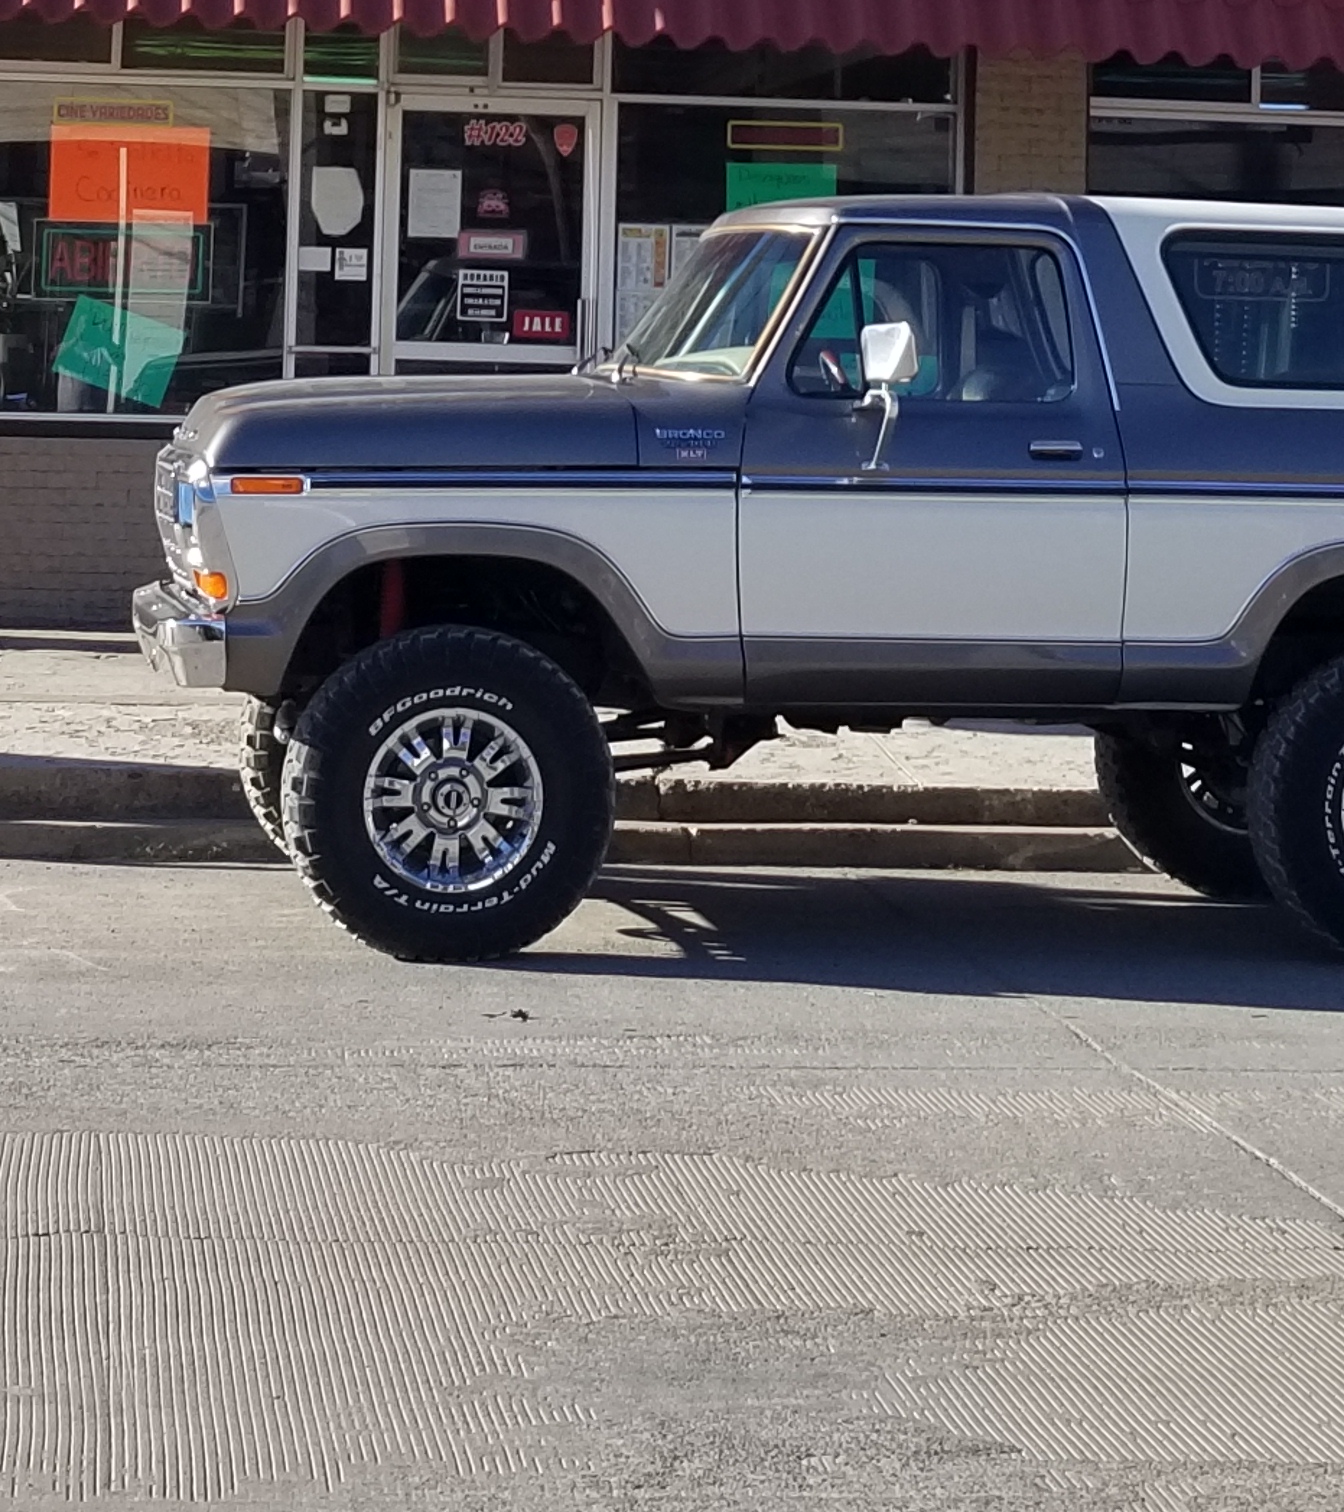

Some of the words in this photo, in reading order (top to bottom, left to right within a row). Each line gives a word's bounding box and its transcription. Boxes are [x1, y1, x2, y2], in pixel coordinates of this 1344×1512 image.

[464, 119, 527, 146] #122
[523, 316, 562, 333] JALE
[655, 428, 726, 439] BRONCO
[680, 449, 704, 458] XLT
[368, 686, 515, 738] BFGoodrich
[373, 873, 411, 906] T/A
[415, 840, 558, 914] Mud-Terrain
